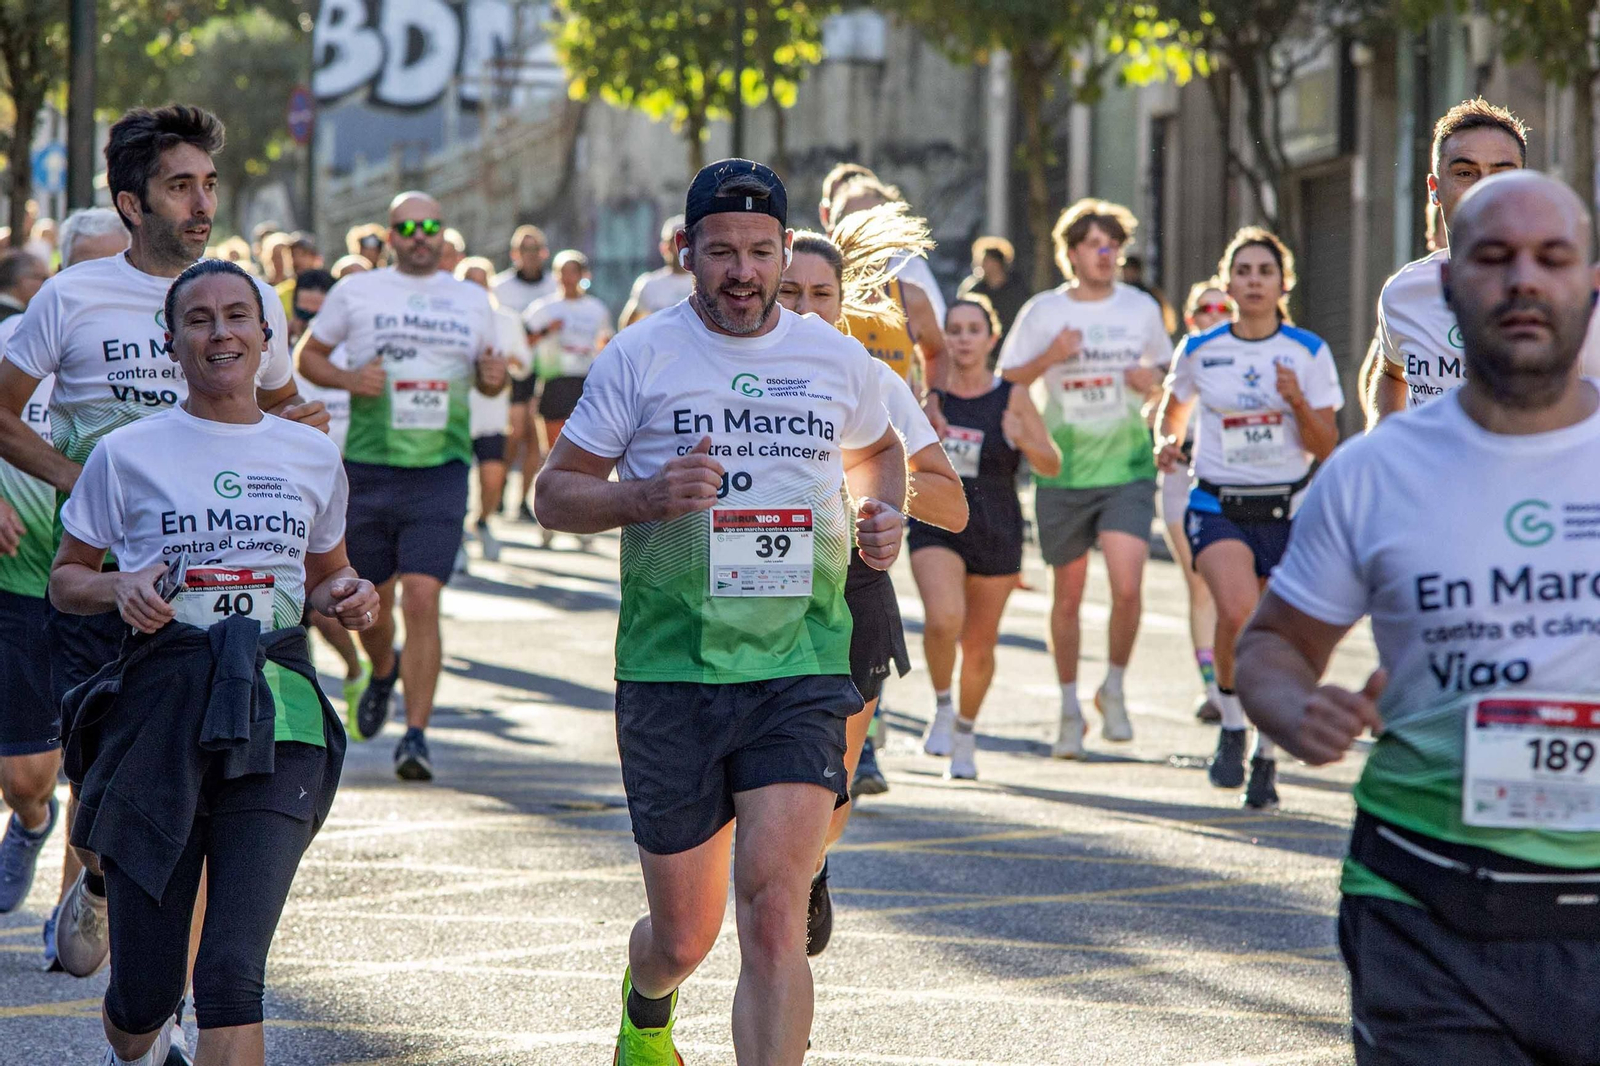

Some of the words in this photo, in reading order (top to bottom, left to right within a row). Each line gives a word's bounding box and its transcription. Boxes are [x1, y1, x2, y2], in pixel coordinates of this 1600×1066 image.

[103, 339, 141, 362] En
[107, 366, 157, 382] contra
[161, 366, 177, 379] el
[1407, 354, 1430, 377] En
[766, 377, 811, 386] asociación
[109, 384, 178, 407] Vigo
[673, 409, 713, 434] En
[723, 408, 834, 441] Marcha
[737, 442, 754, 456] el
[758, 442, 817, 460] cáncer
[247, 482, 282, 491] española
[274, 491, 282, 499] el
[162, 511, 197, 535] En
[206, 508, 306, 539] Marcha
[162, 540, 215, 556] contra
[218, 535, 232, 550] el
[236, 538, 288, 554] cáncer
[755, 534, 792, 559] 39
[213, 592, 254, 616] 40
[1416, 573, 1472, 612] En
[1422, 621, 1503, 644] contra
[1511, 616, 1537, 638] el
[1526, 738, 1596, 774] 189
